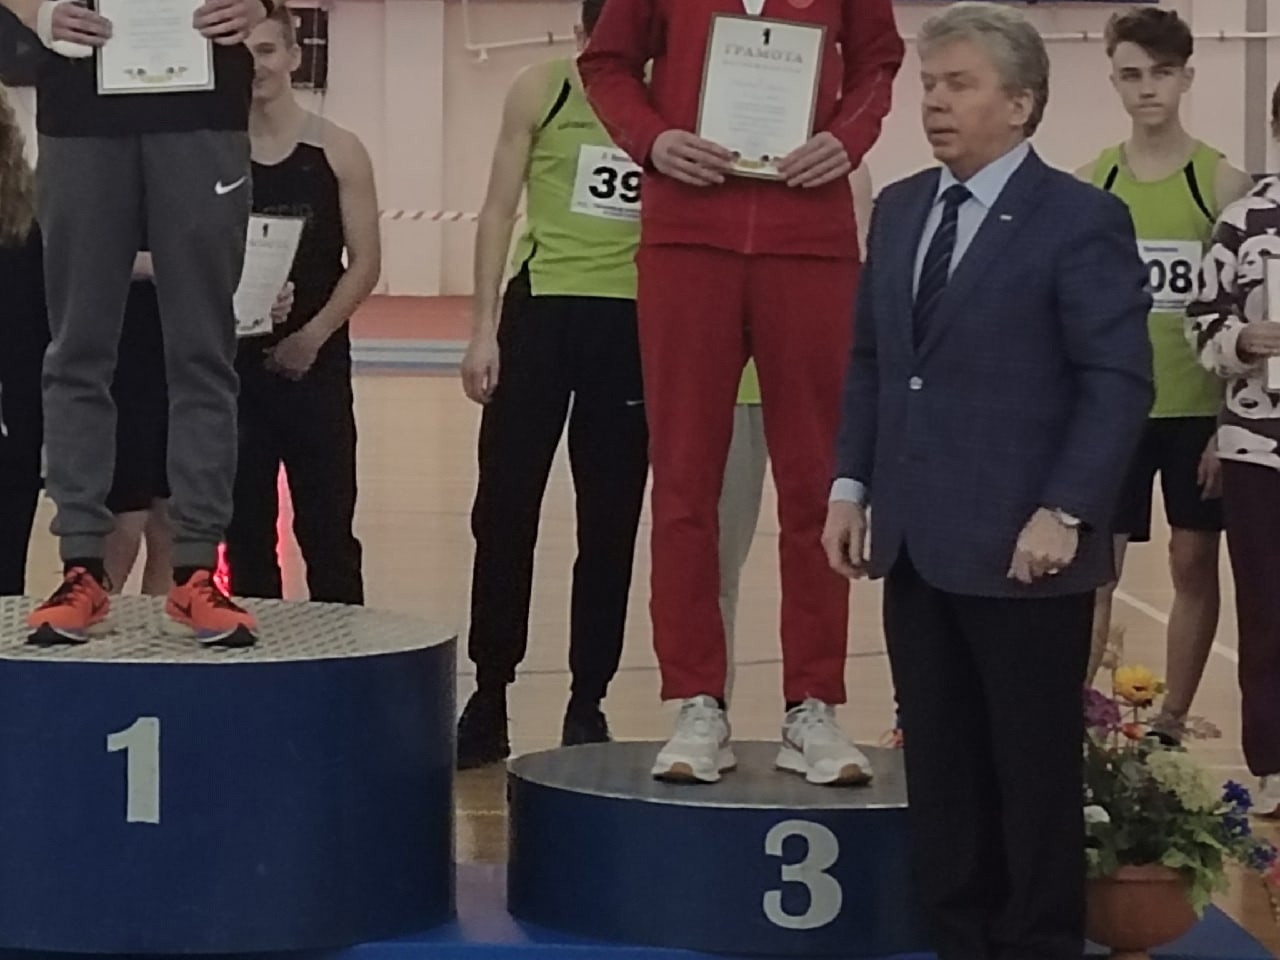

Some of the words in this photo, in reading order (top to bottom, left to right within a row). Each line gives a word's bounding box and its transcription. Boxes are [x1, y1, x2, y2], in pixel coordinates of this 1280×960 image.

[724, 44, 804, 64] ГРАМОТА
[107, 716, 160, 824] 1
[763, 819, 843, 929] 3
